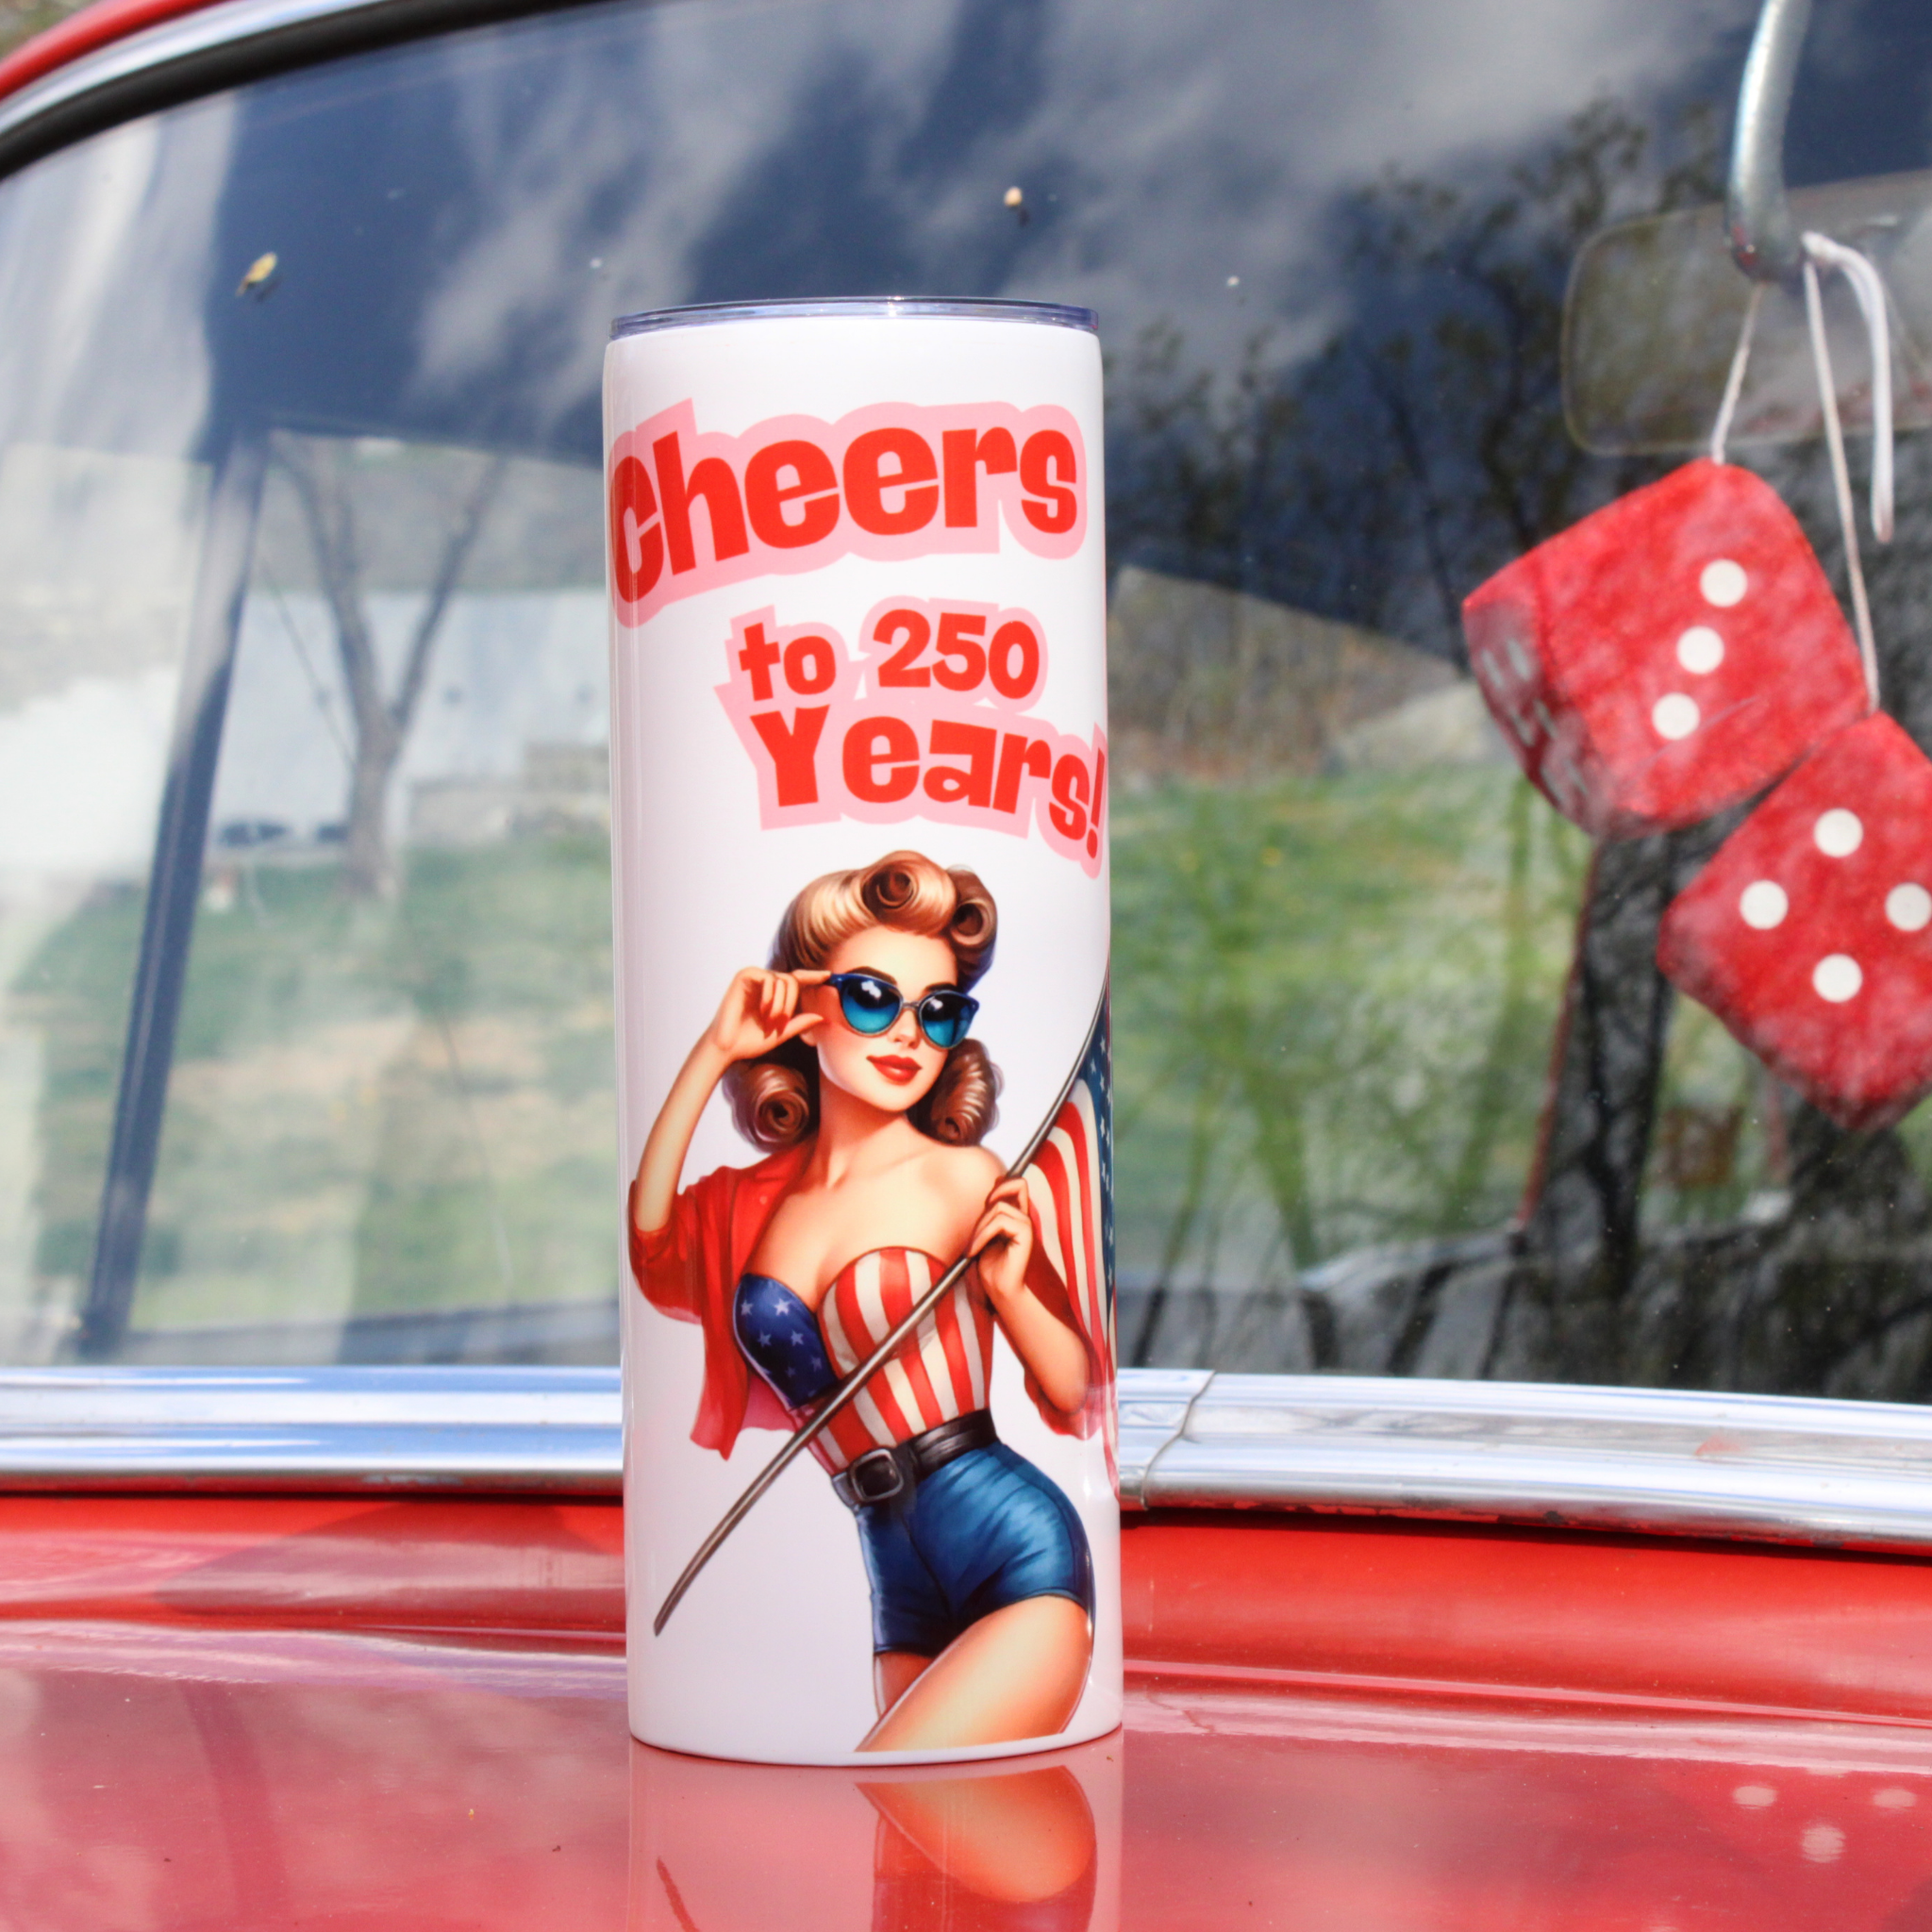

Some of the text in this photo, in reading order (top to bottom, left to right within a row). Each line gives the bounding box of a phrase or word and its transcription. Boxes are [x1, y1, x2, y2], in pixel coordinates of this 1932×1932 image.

[609, 427, 1077, 604] Cheers
[739, 609, 1040, 702] to 250
[749, 705, 1106, 859] Years!
